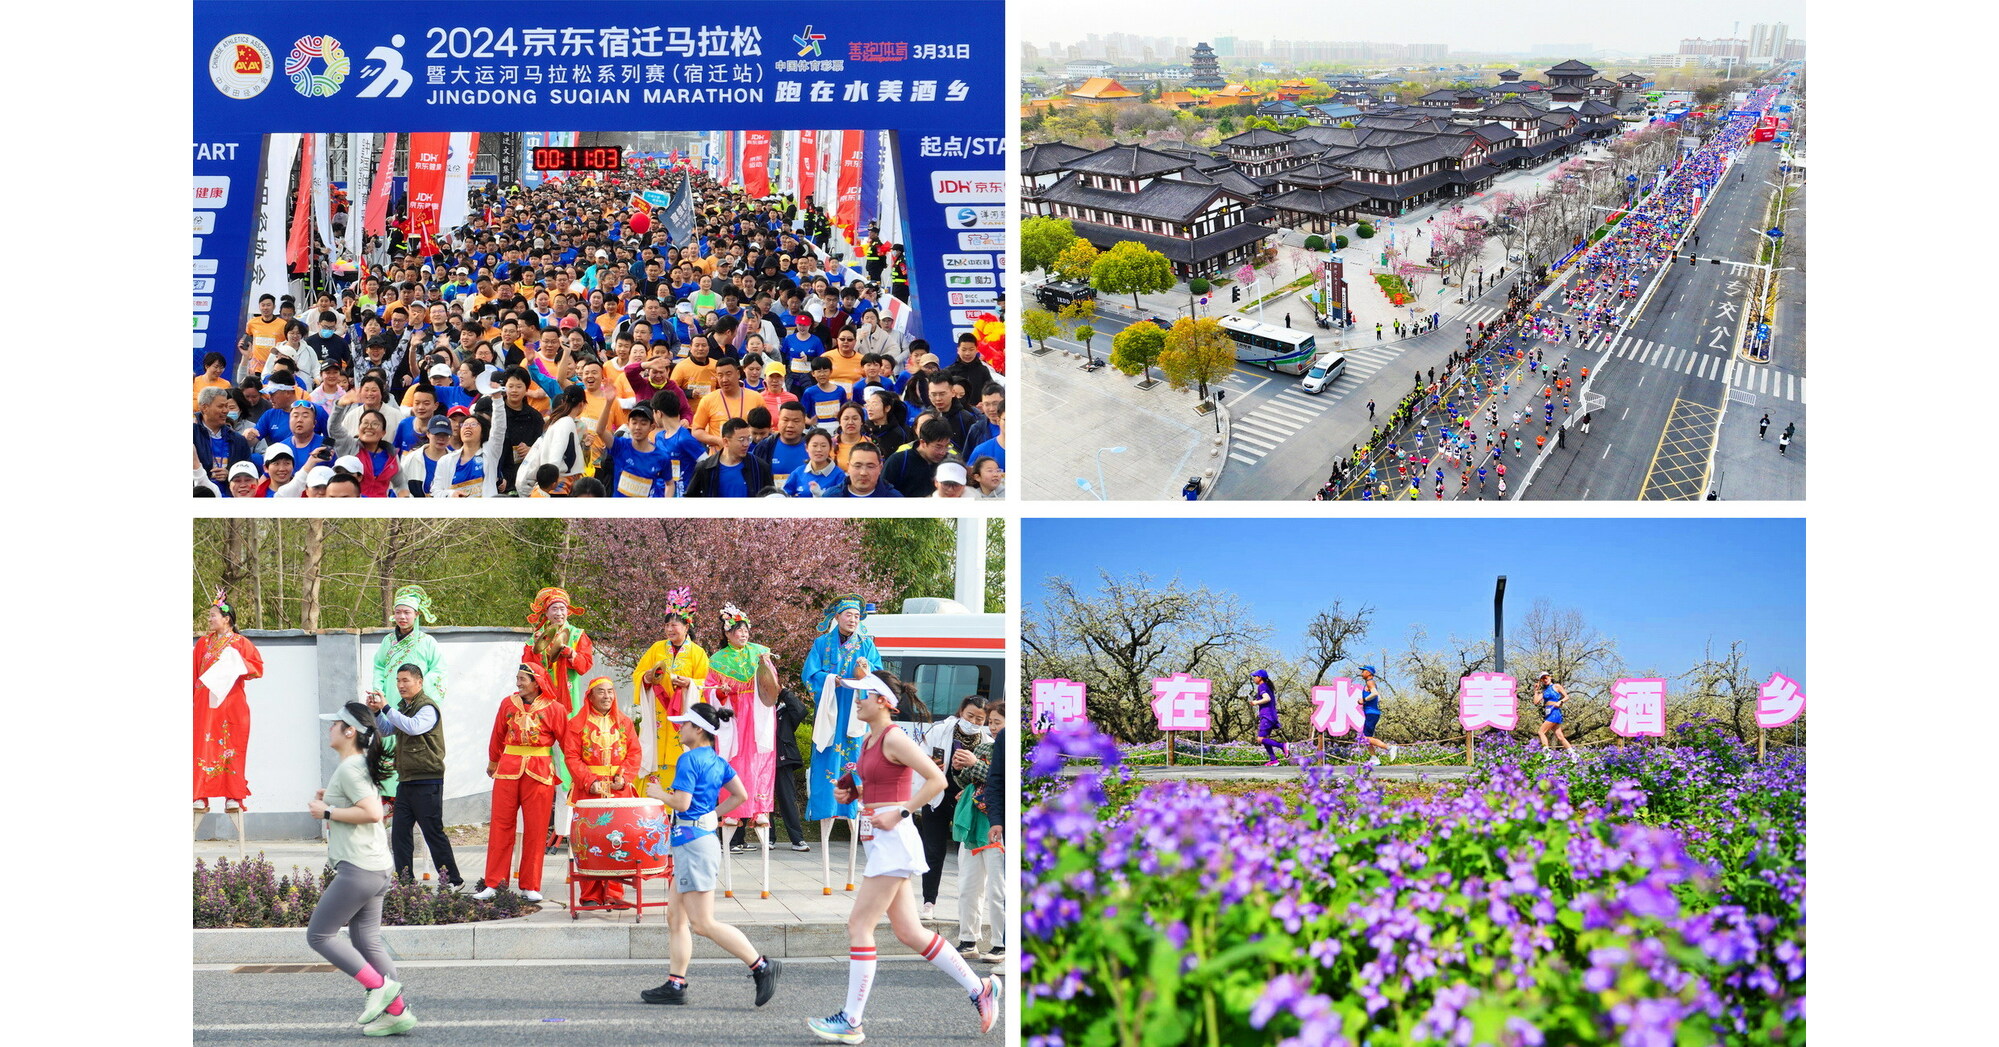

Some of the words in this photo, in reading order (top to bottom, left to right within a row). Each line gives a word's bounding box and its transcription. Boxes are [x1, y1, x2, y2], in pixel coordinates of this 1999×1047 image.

[912, 44, 970, 60] 3月31日
[775, 59, 845, 72] 中国体育彩票
[427, 90, 537, 105] JINGDONG
[550, 89, 630, 105] SUQIAN
[643, 88, 763, 103] MARATHON
[774, 80, 970, 103] 跑在水美酒乡
[536, 149, 618, 168] 00:11:03
[193, 187, 224, 199] 健康
[975, 182, 1005, 193] 京东
[1155, 676, 1208, 727] 在
[1314, 680, 1365, 733] 水
[1462, 676, 1516, 727] 美
[1613, 681, 1664, 734] 酒
[1756, 675, 1805, 725] 乡
